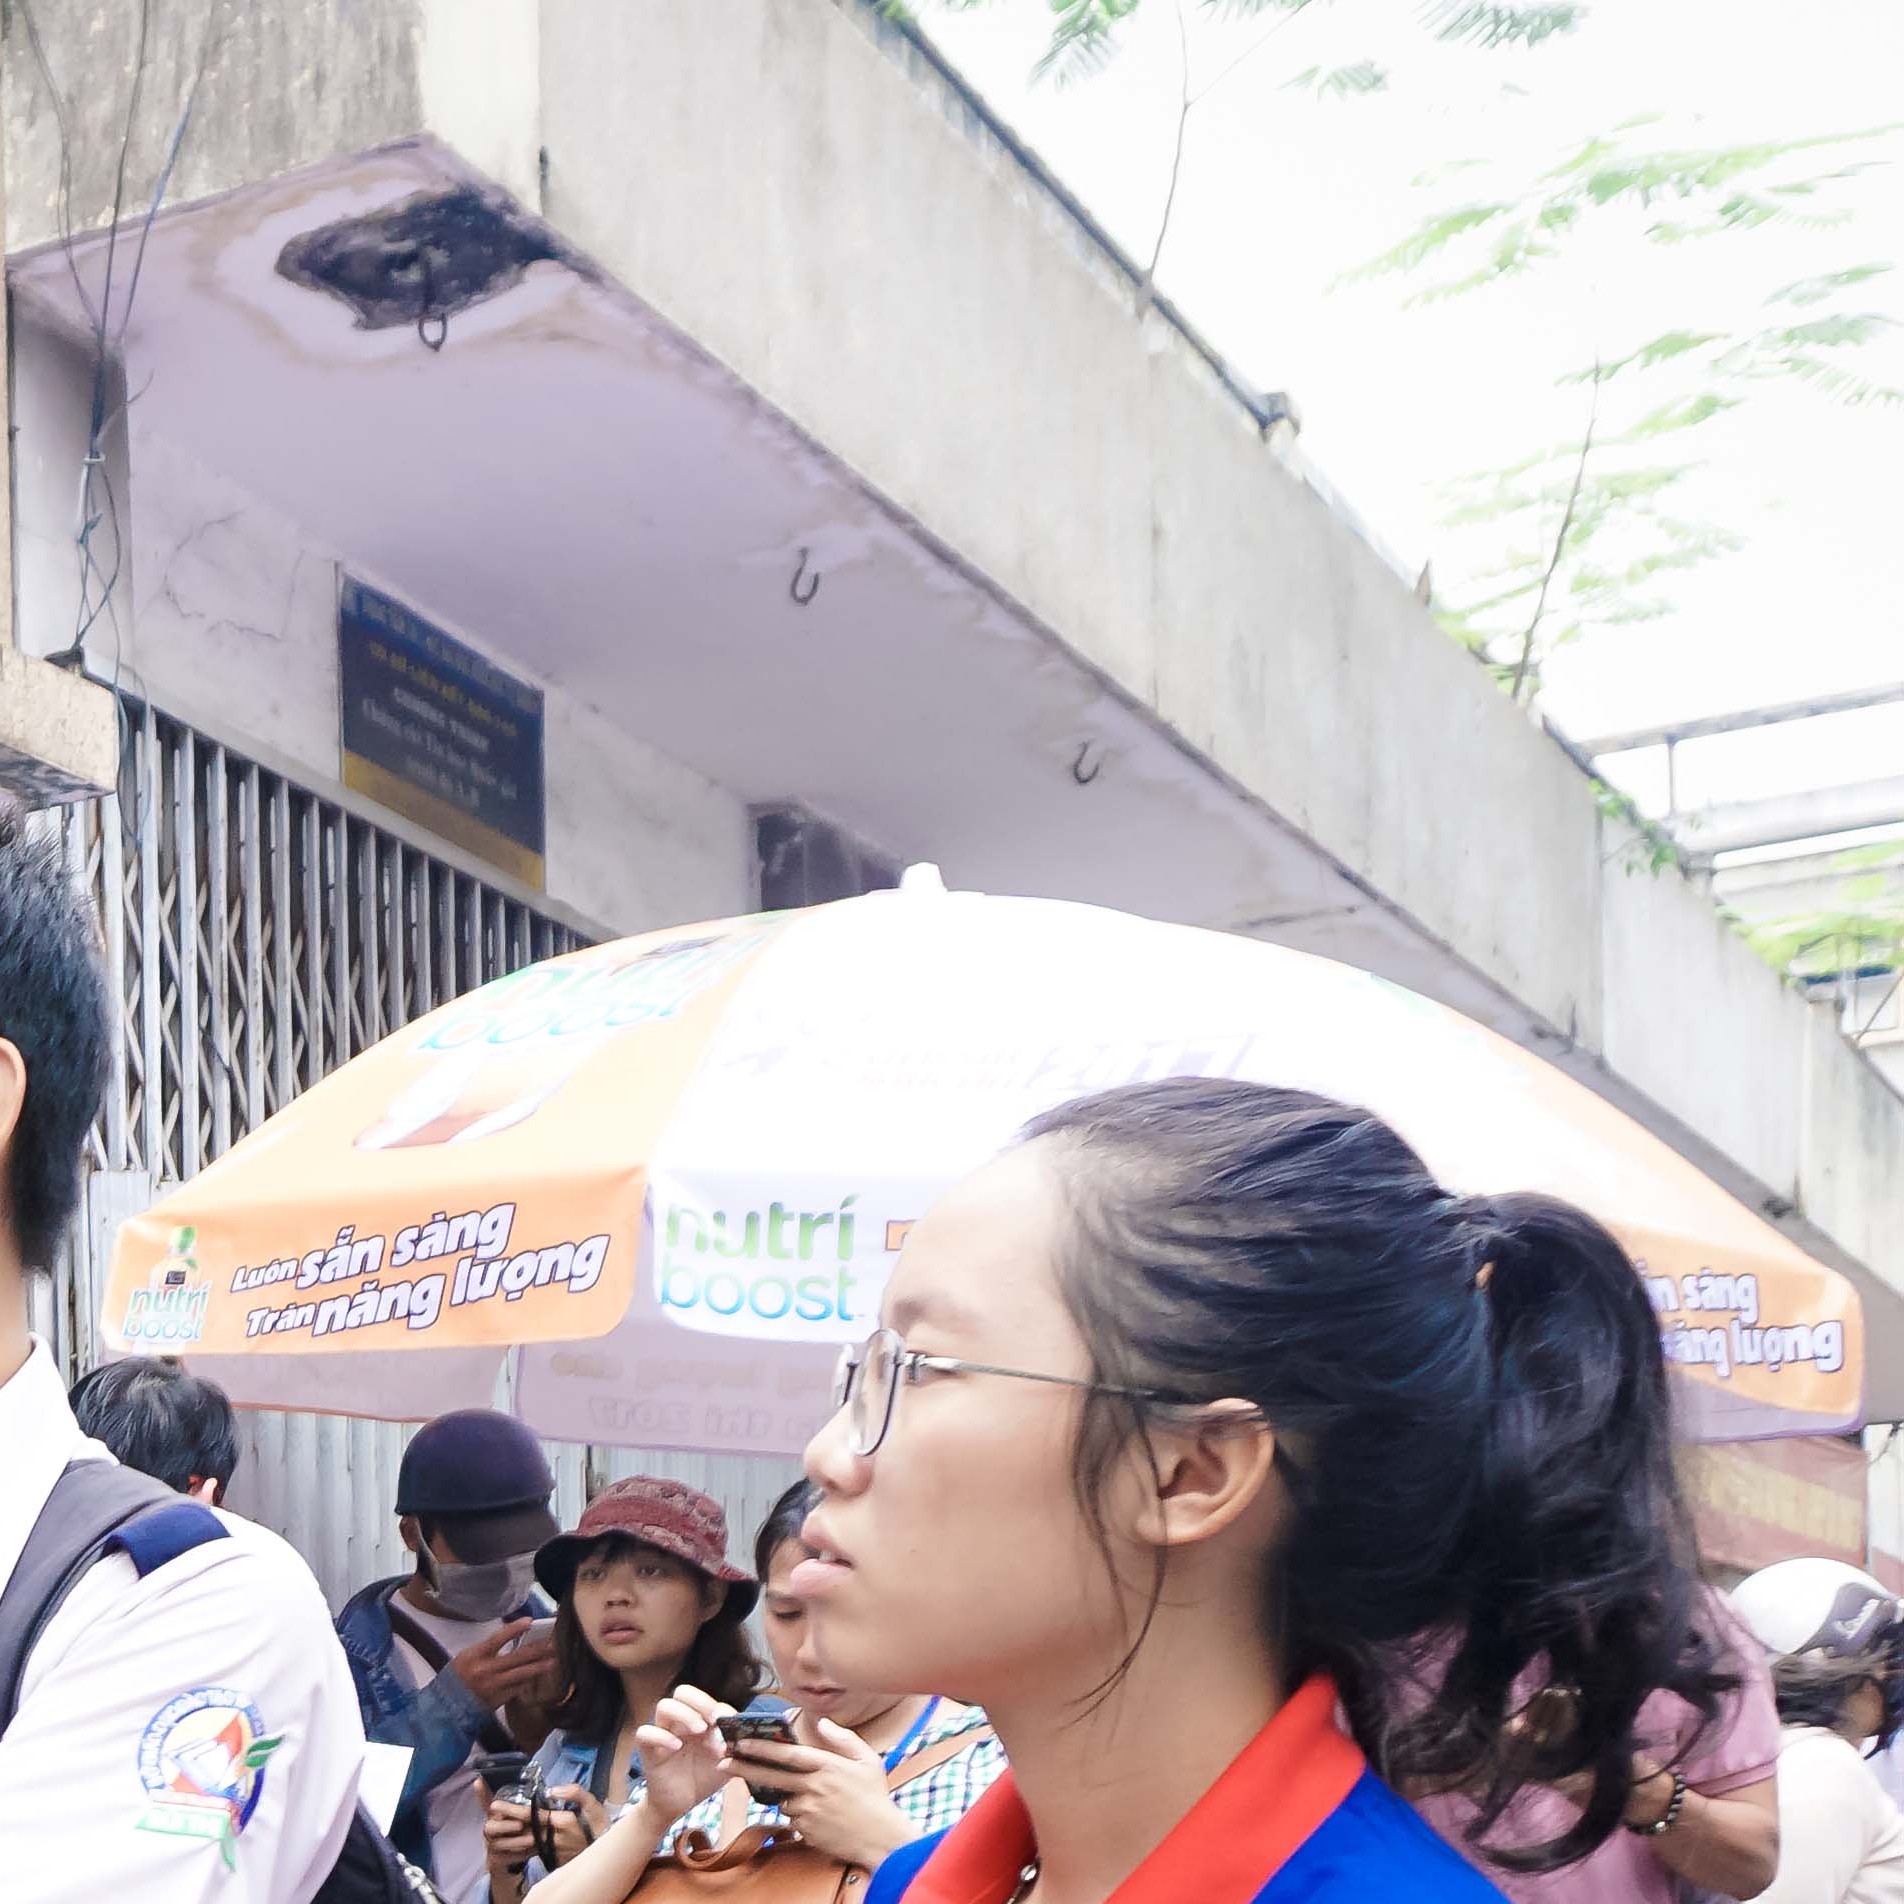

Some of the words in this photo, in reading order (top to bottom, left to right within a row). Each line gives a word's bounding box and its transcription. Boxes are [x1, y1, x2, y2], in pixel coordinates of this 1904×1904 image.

[449, 1235, 610, 1306] lượng
[659, 1253, 857, 1321] boost
[122, 1313, 205, 1341] boost
